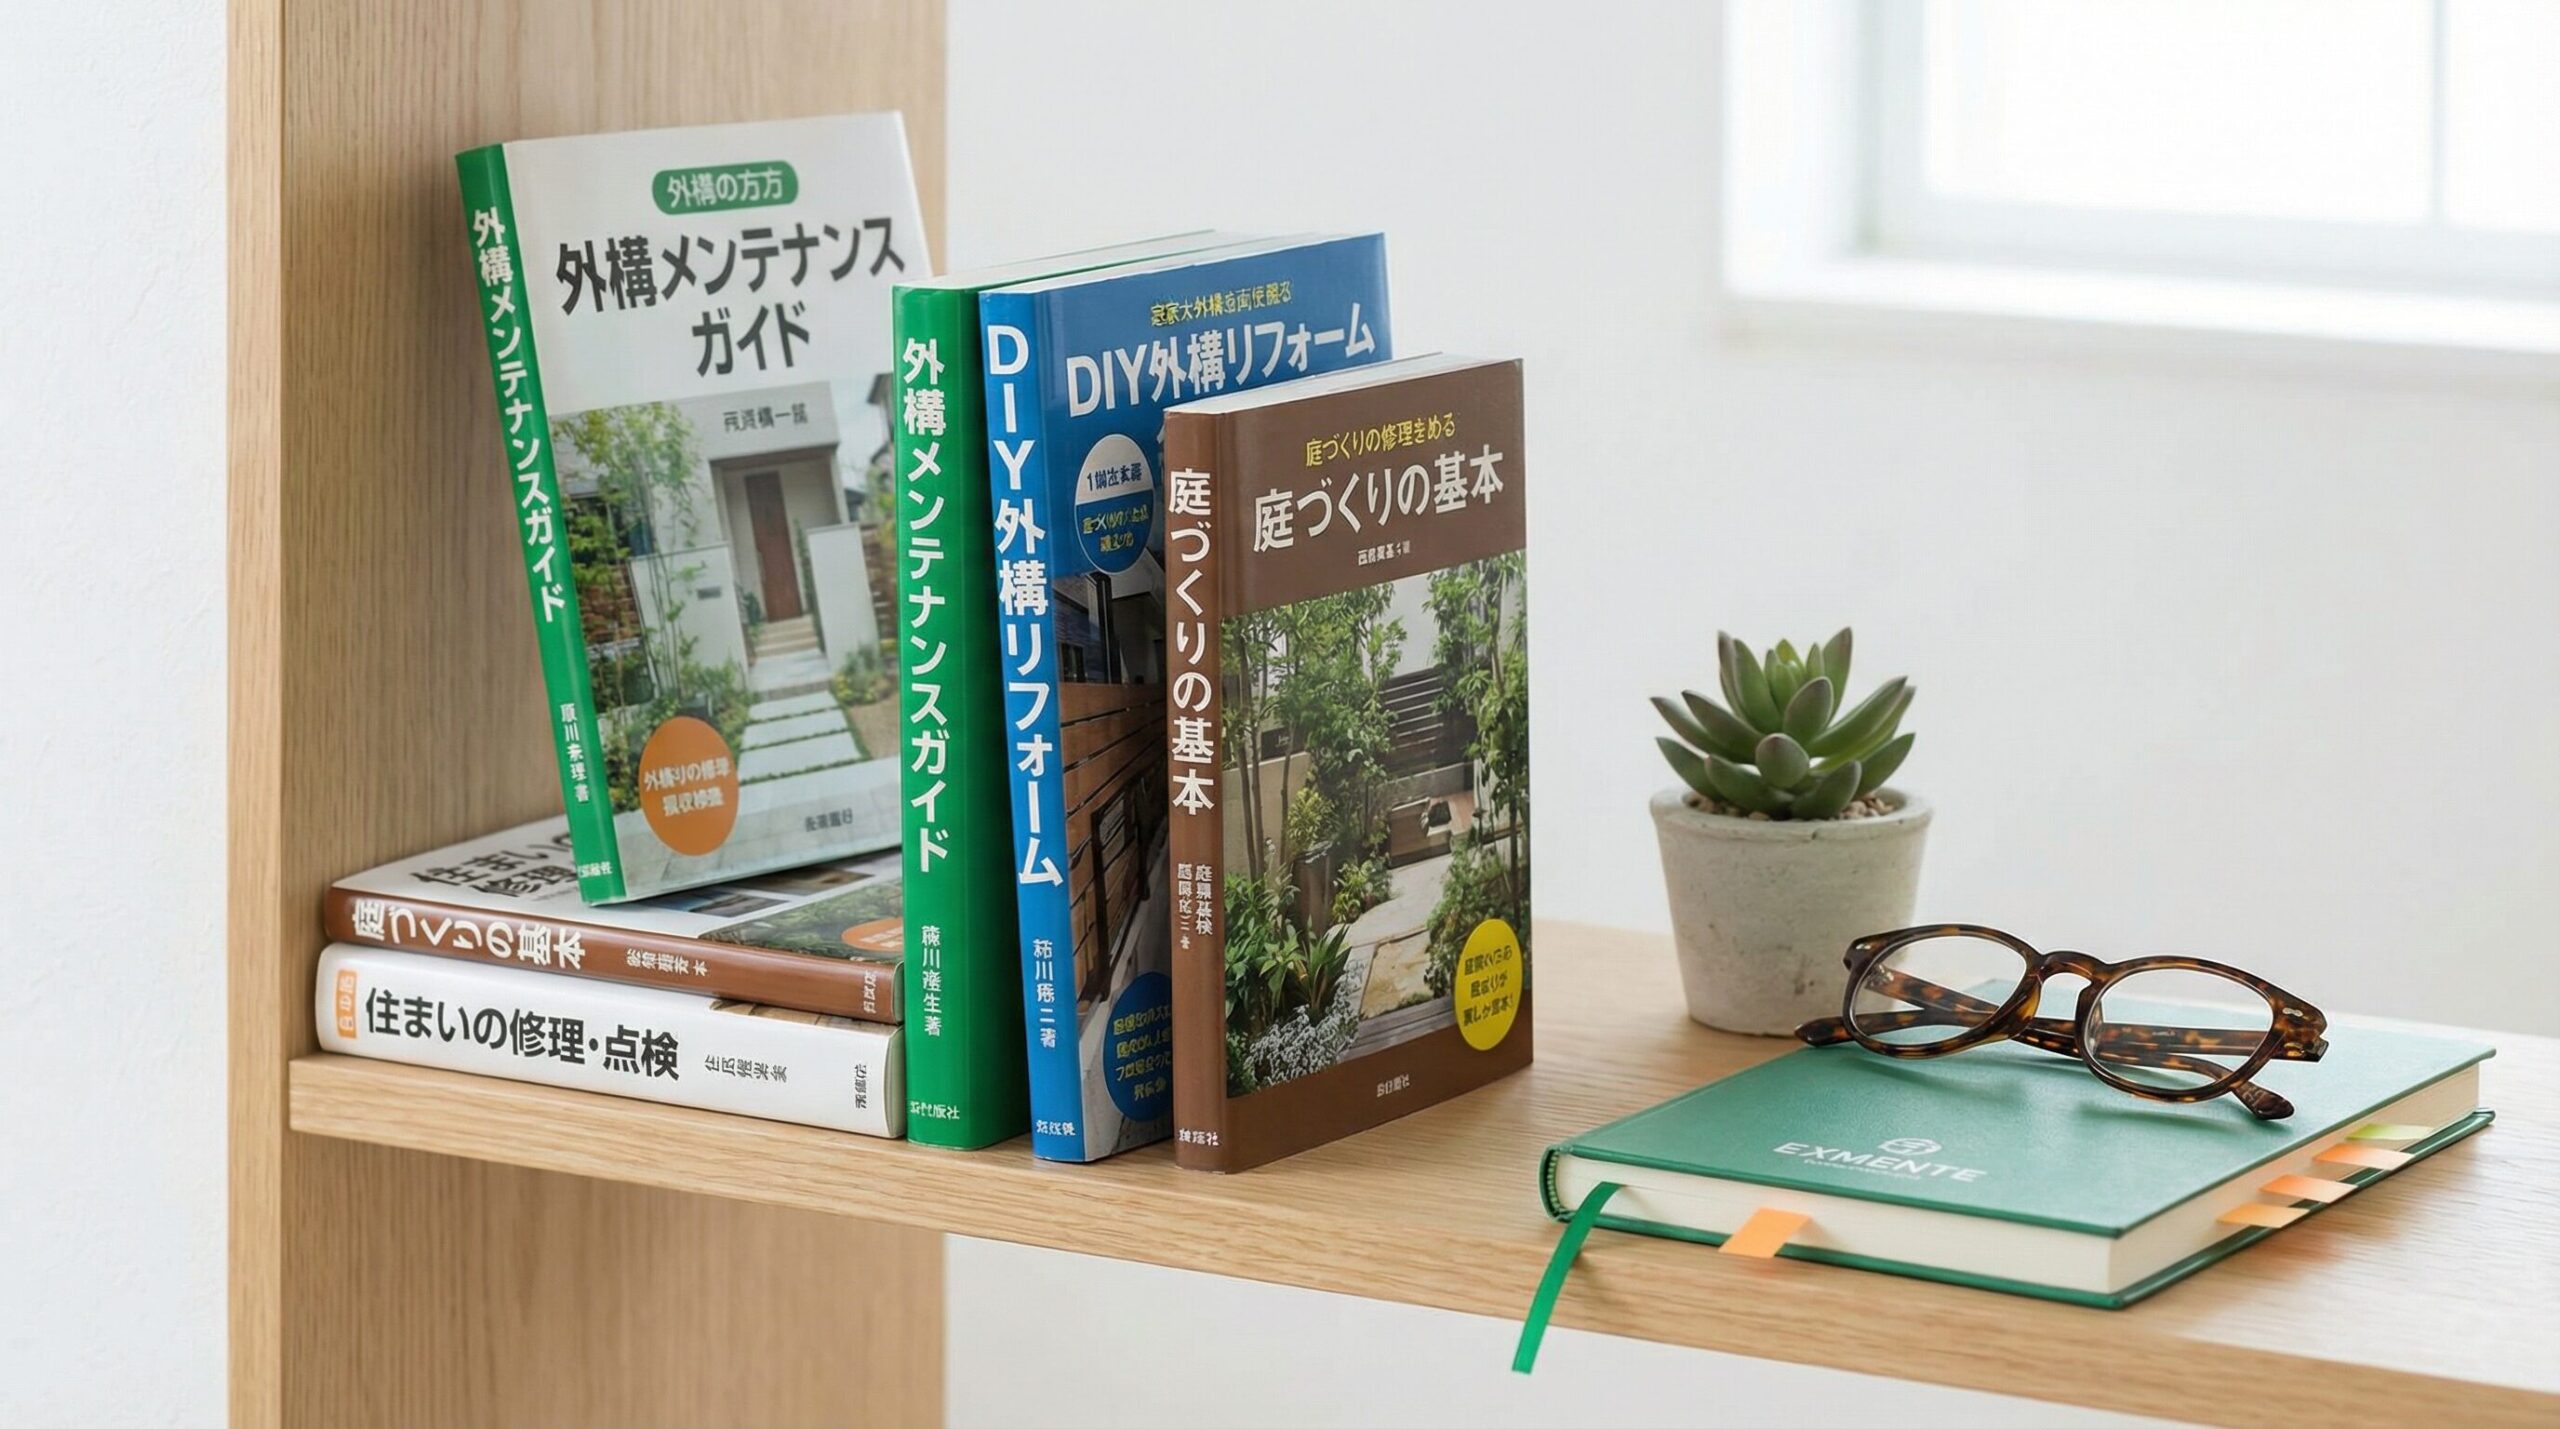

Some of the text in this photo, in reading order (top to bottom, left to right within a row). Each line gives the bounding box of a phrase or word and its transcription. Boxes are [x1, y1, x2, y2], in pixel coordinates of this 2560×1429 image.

[557, 217, 906, 316] 外構メンテナンス
[692, 300, 810, 377] ガイド
[1066, 302, 1376, 417] DIY外構リフォーム
[473, 206, 565, 623] 外構メンテナンスガイド
[1254, 444, 1504, 552] 庭づくりの基本
[902, 337, 951, 873] 外構メンテナンスガイド
[987, 324, 1064, 887] DIY外構リフォーム
[1168, 467, 1215, 816] 庭づくりの基本
[352, 899, 586, 970] 庭づくりの基本
[366, 987, 680, 1081] 住まいの修理・点検
[1773, 1142, 1988, 1183] EXMENTE
